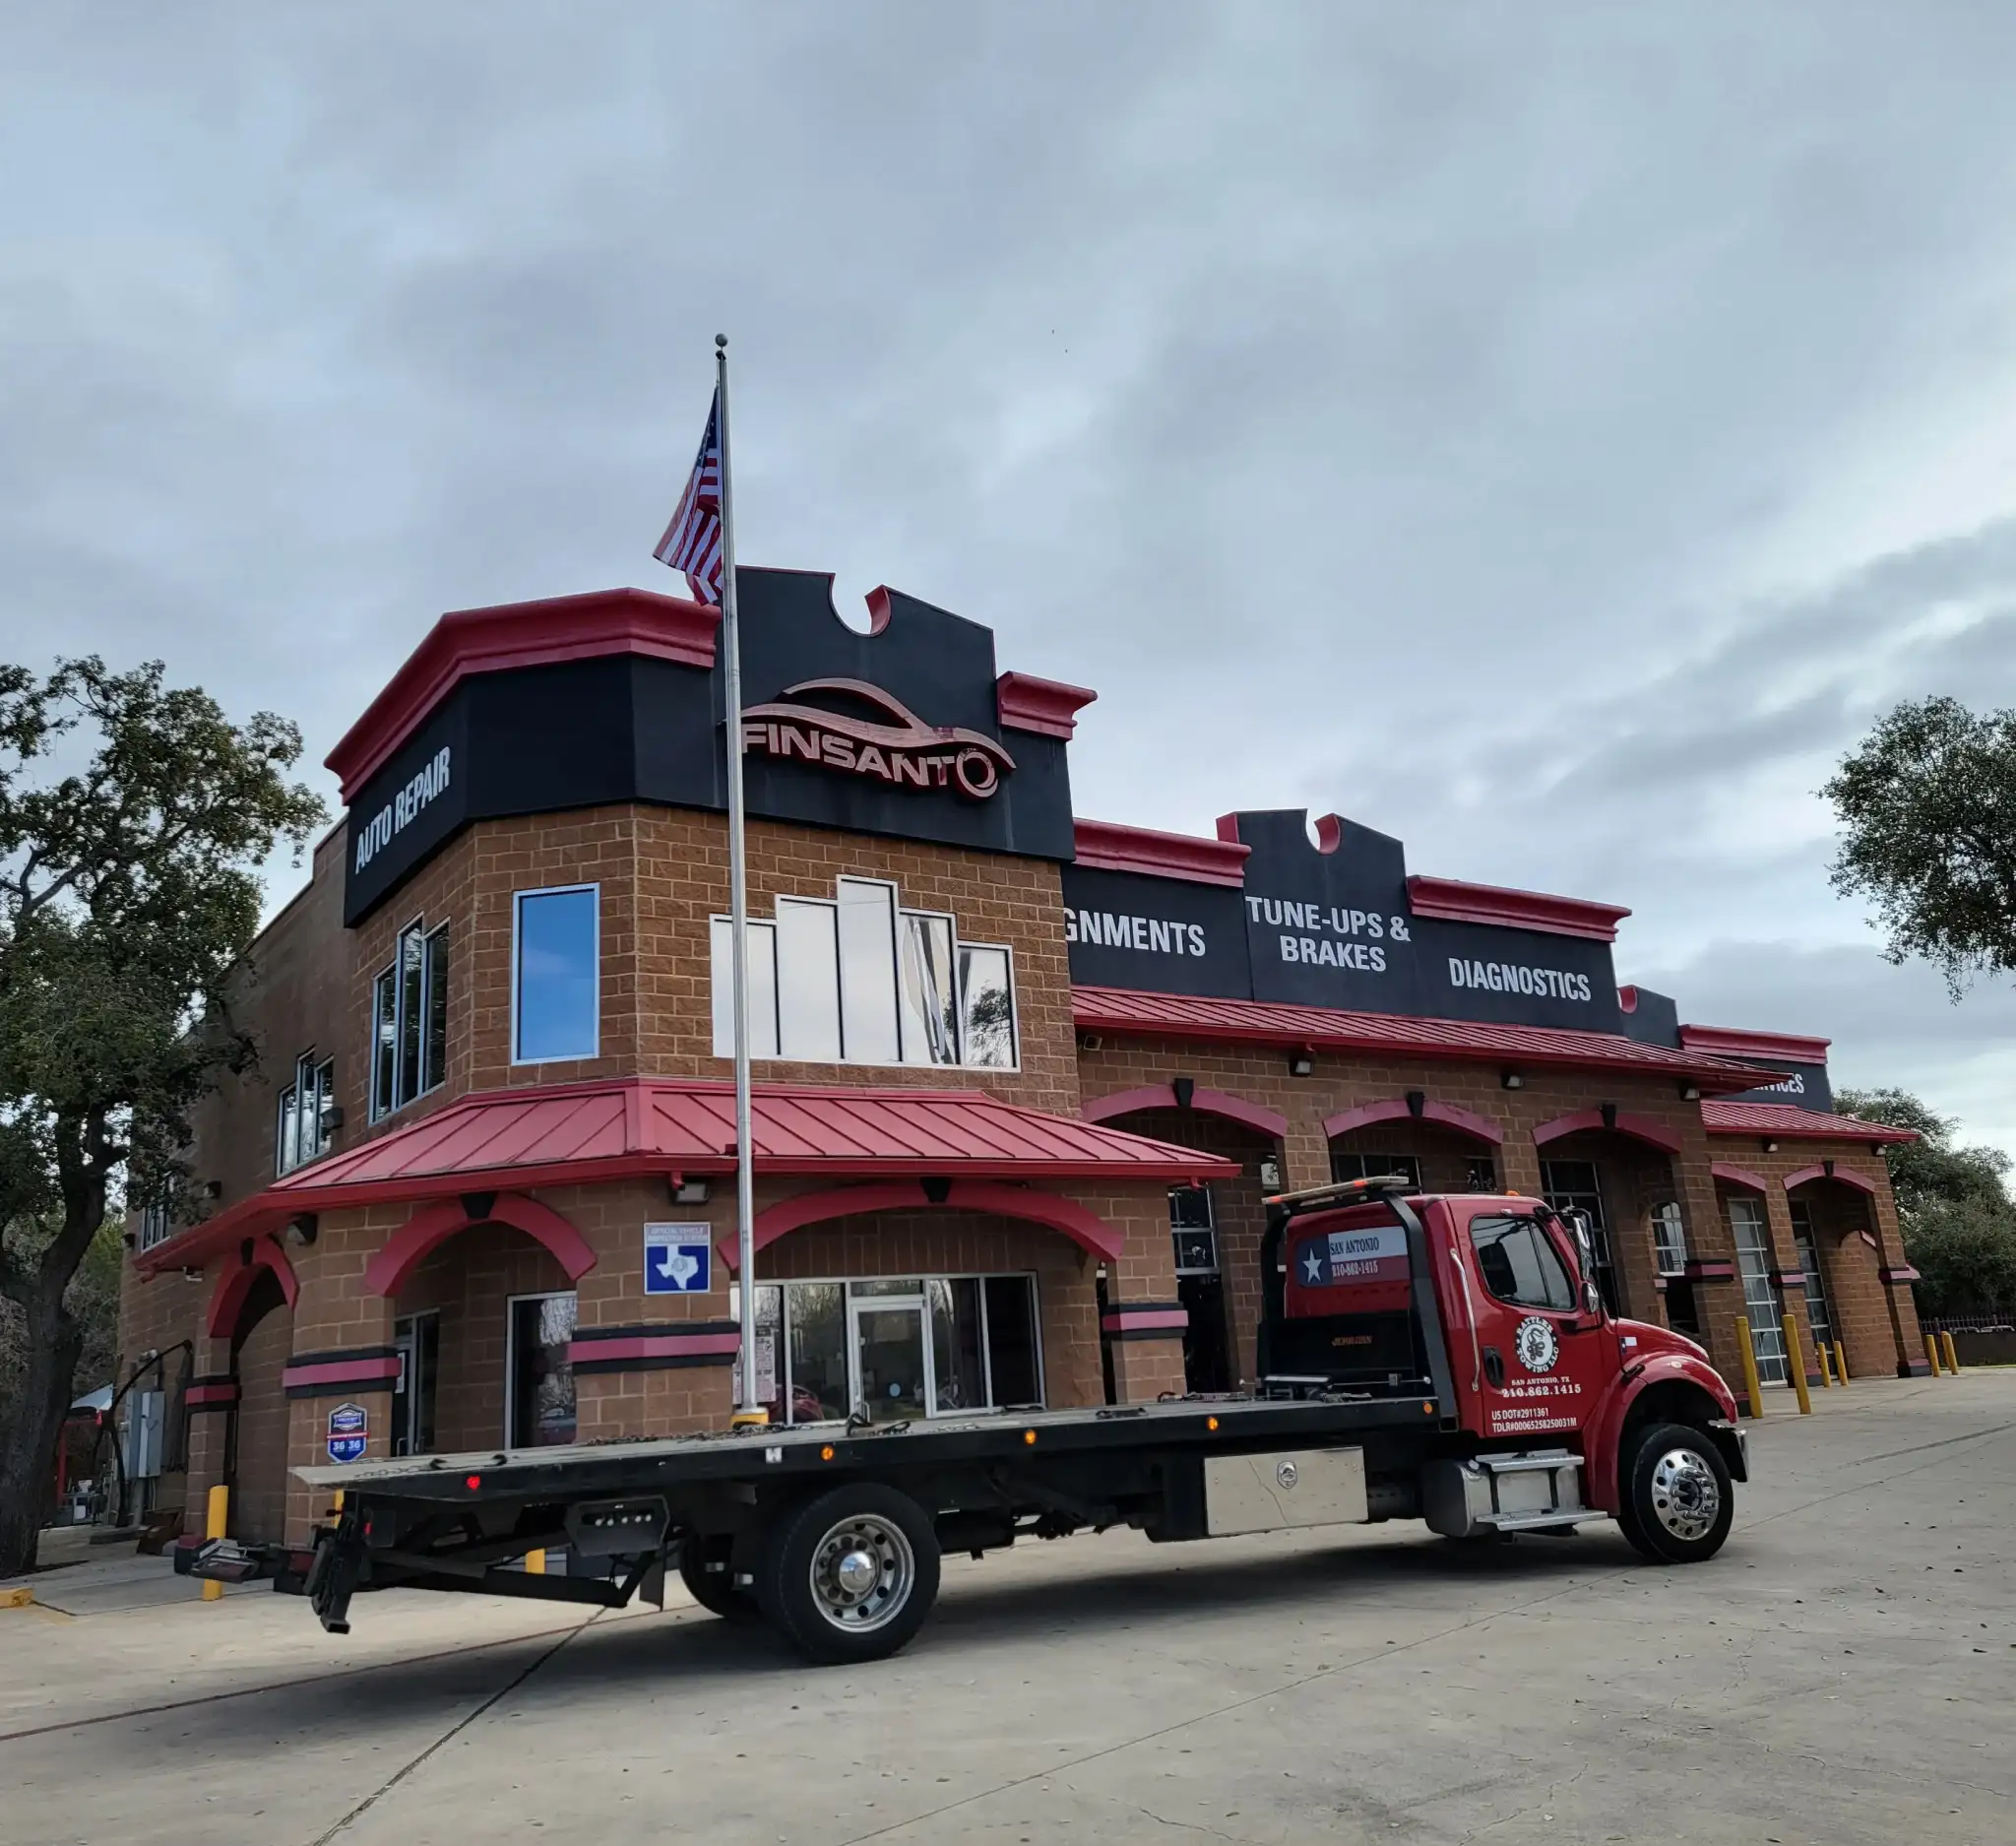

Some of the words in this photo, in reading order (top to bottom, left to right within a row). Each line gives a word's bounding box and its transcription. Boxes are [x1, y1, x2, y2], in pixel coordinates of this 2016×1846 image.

[741, 723, 999, 797] FINSANTO
[355, 803, 393, 875] AUTO
[395, 746, 451, 835] REPAIR
[1245, 895, 1384, 938] TUNE-UPS
[1389, 916, 1412, 942] &
[1280, 934, 1387, 972] BRAKES
[1448, 957, 1592, 1001] DIAGNOSTICS
[1330, 1242, 1344, 1256] SAN
[1346, 1237, 1380, 1253] ANTONIO
[1517, 1316, 1553, 1335] RATTLER
[1517, 1347, 1549, 1373] TOWING
[1501, 1384, 1582, 1397] 210.862.1415
[1491, 1410, 1502, 1421] US
[333, 1441, 345, 1450] 36
